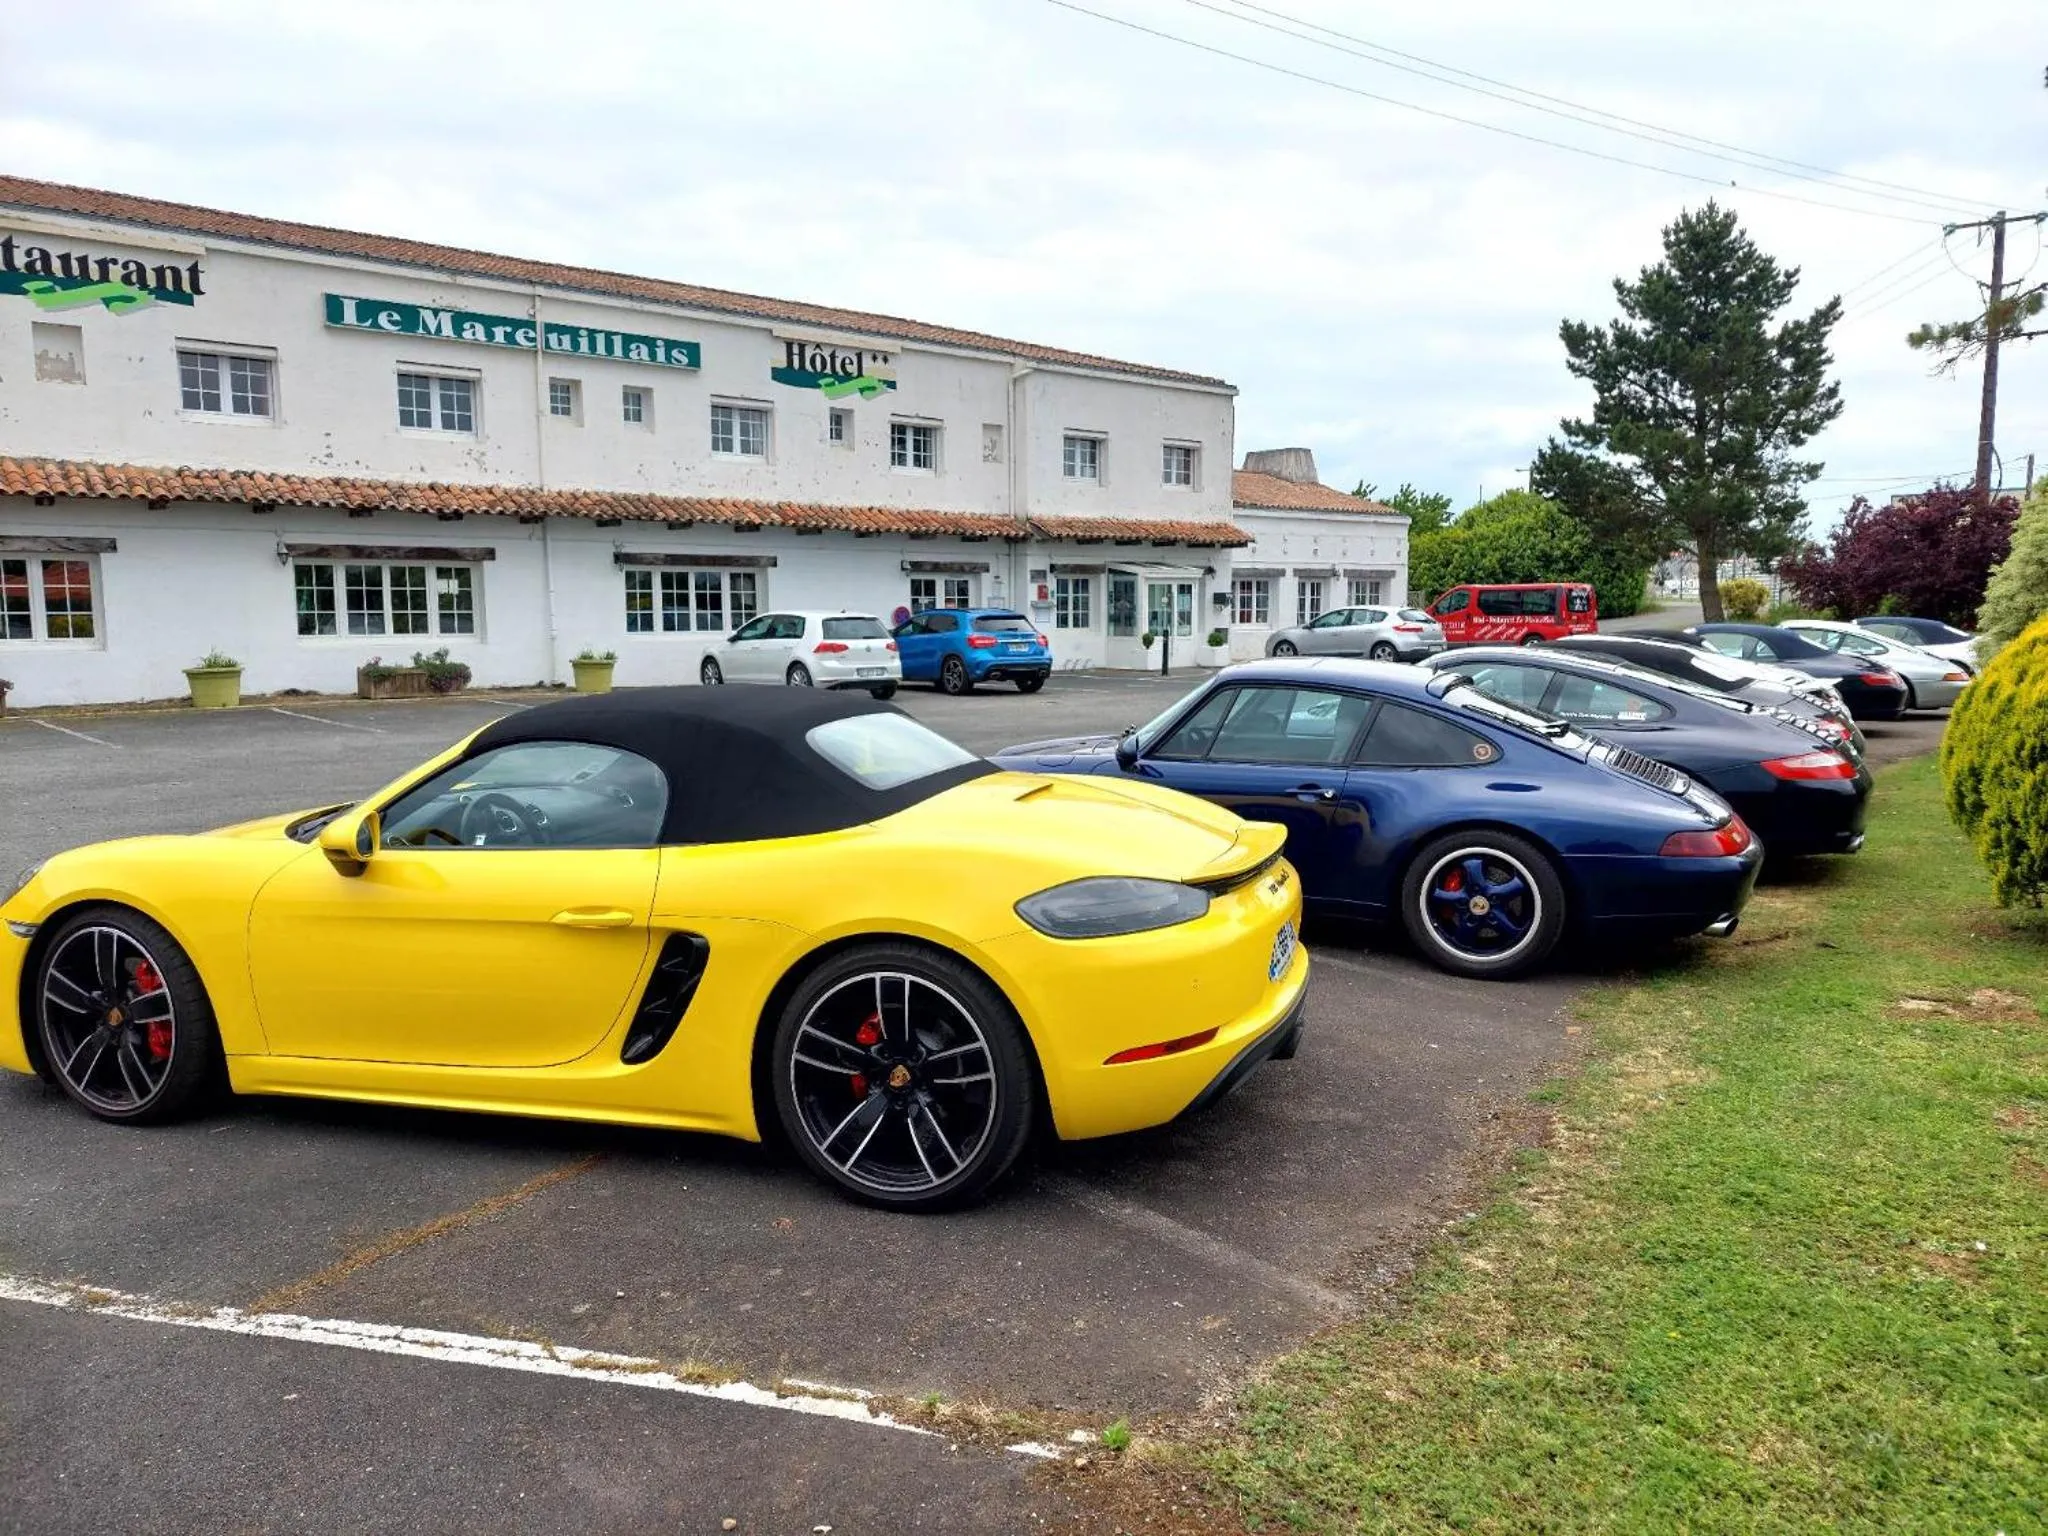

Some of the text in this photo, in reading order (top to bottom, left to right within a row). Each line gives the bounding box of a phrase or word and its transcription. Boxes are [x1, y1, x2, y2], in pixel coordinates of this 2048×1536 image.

[339, 298, 689, 366] Le Mareuillais
[784, 341, 864, 378] Hôtel
